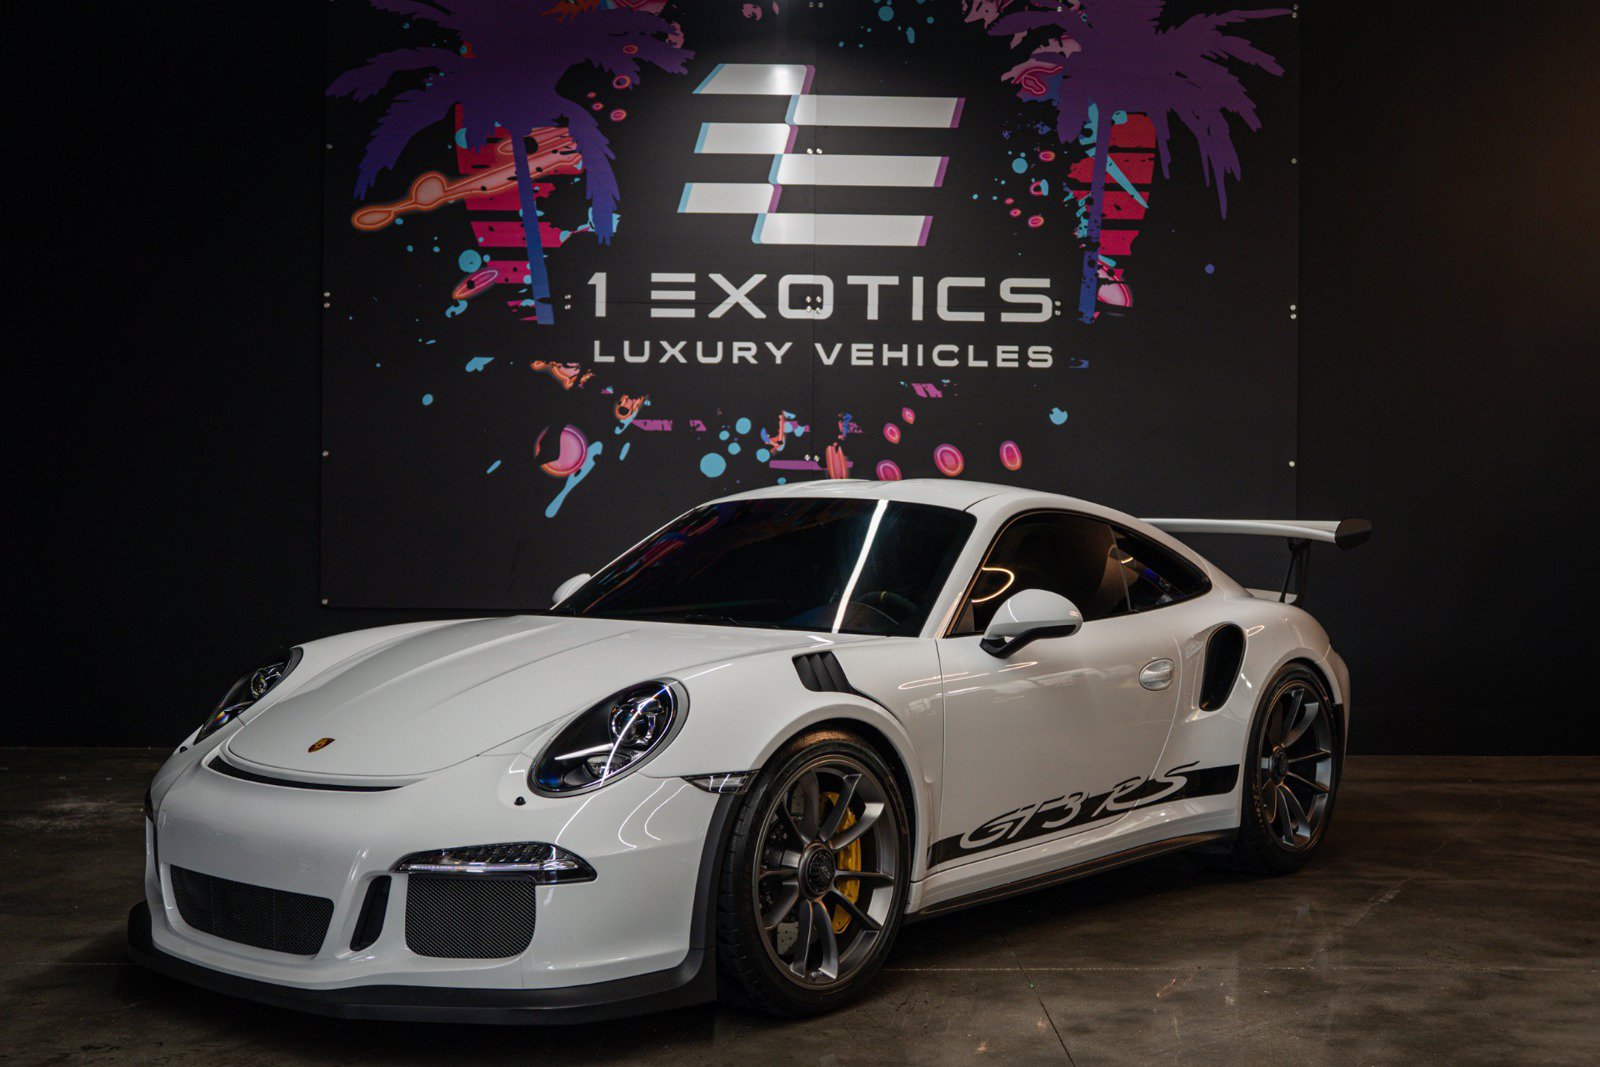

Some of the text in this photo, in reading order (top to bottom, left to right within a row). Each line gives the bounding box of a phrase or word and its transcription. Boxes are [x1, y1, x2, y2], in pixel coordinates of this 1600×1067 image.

[587, 272, 1053, 323] 1 EXOTICS
[593, 340, 1054, 368] LUXURY VEHICLES
[959, 760, 1201, 849] GT3 RS
